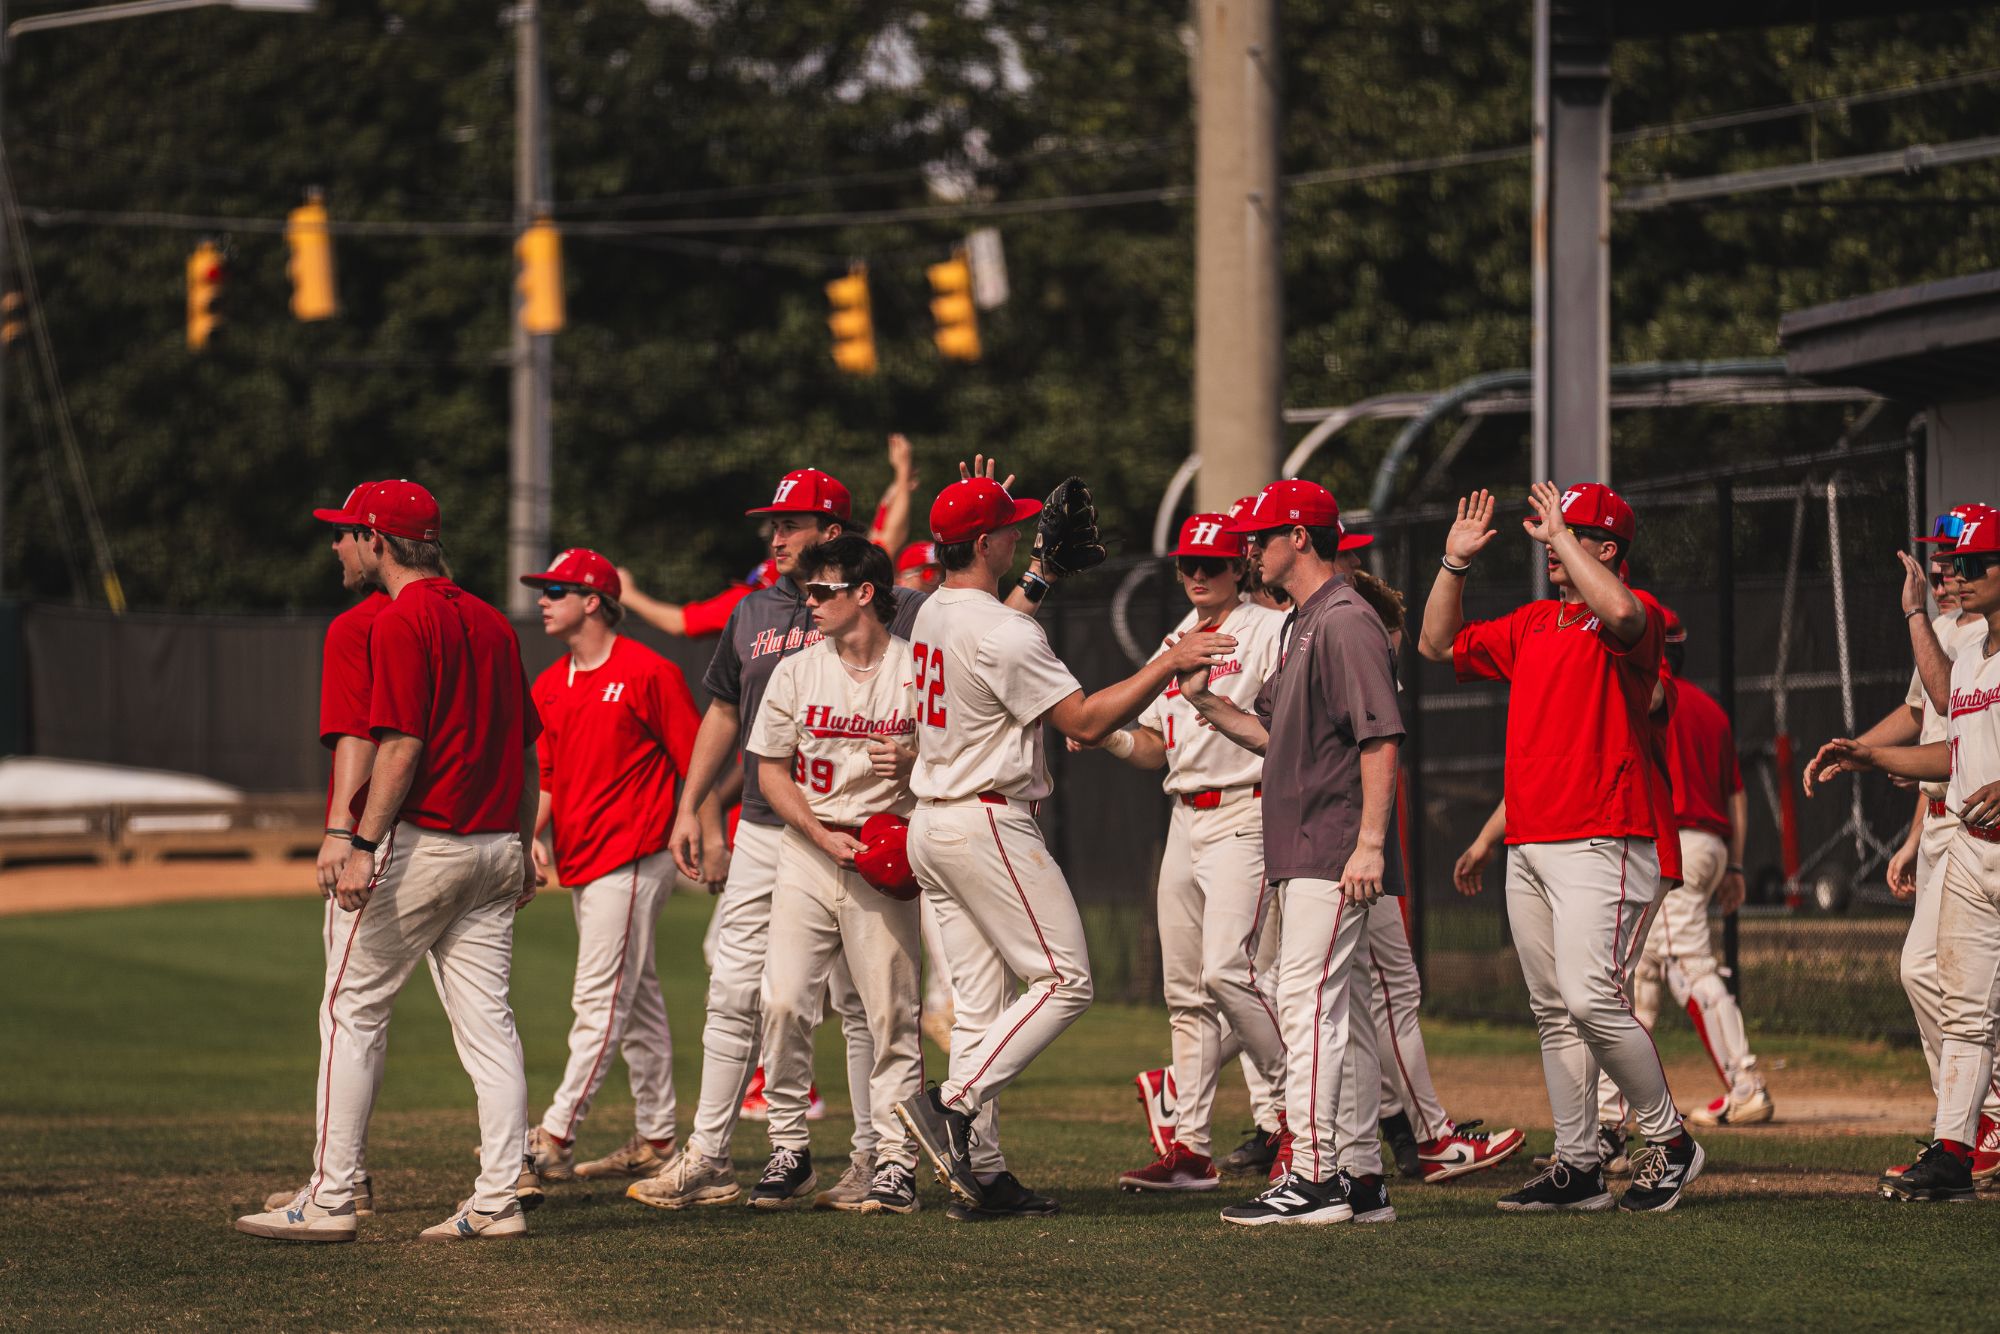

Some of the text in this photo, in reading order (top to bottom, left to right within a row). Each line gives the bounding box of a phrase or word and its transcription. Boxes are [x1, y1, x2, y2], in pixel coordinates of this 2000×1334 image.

[772, 480, 799, 504] H
[1189, 522, 1223, 545] H
[1956, 522, 1982, 548] H
[1580, 616, 1601, 631] H
[600, 682, 625, 702] H
[913, 641, 947, 731] 22
[802, 704, 916, 735] Huntingdon
